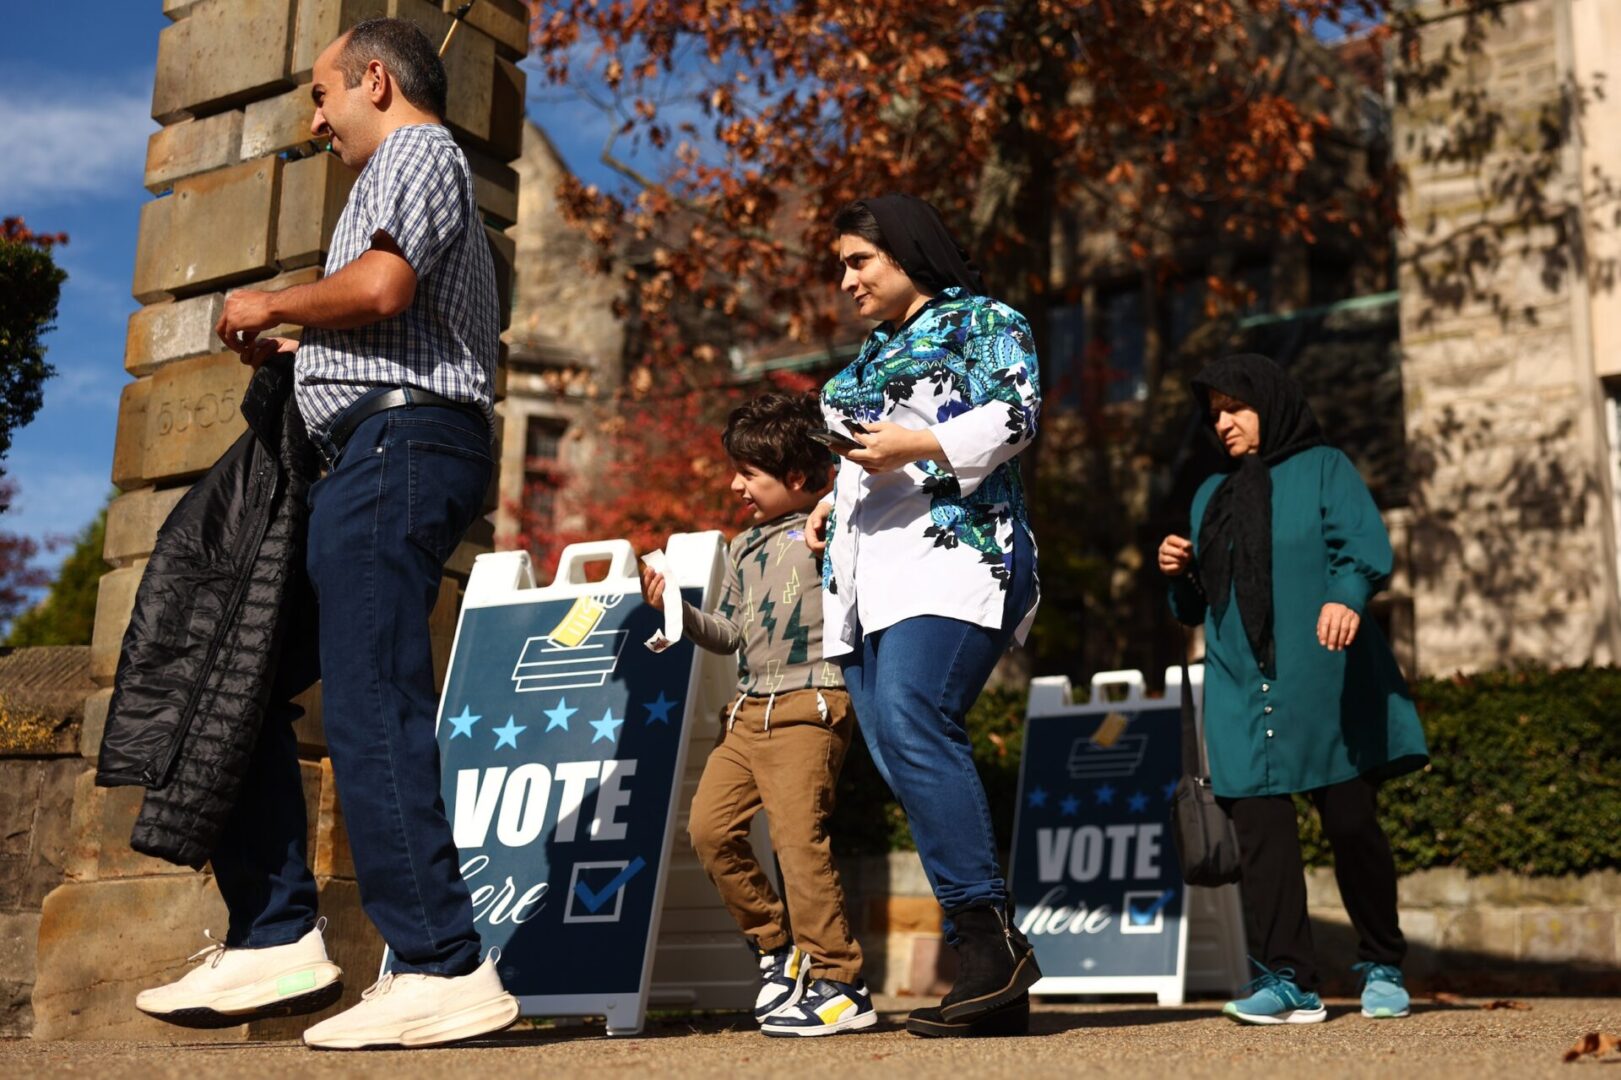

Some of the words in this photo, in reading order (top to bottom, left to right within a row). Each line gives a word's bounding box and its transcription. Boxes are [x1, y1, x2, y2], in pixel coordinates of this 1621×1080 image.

[453, 759, 638, 848] VOTE
[1036, 823, 1163, 882] VOTE
[1018, 885, 1112, 935] here
